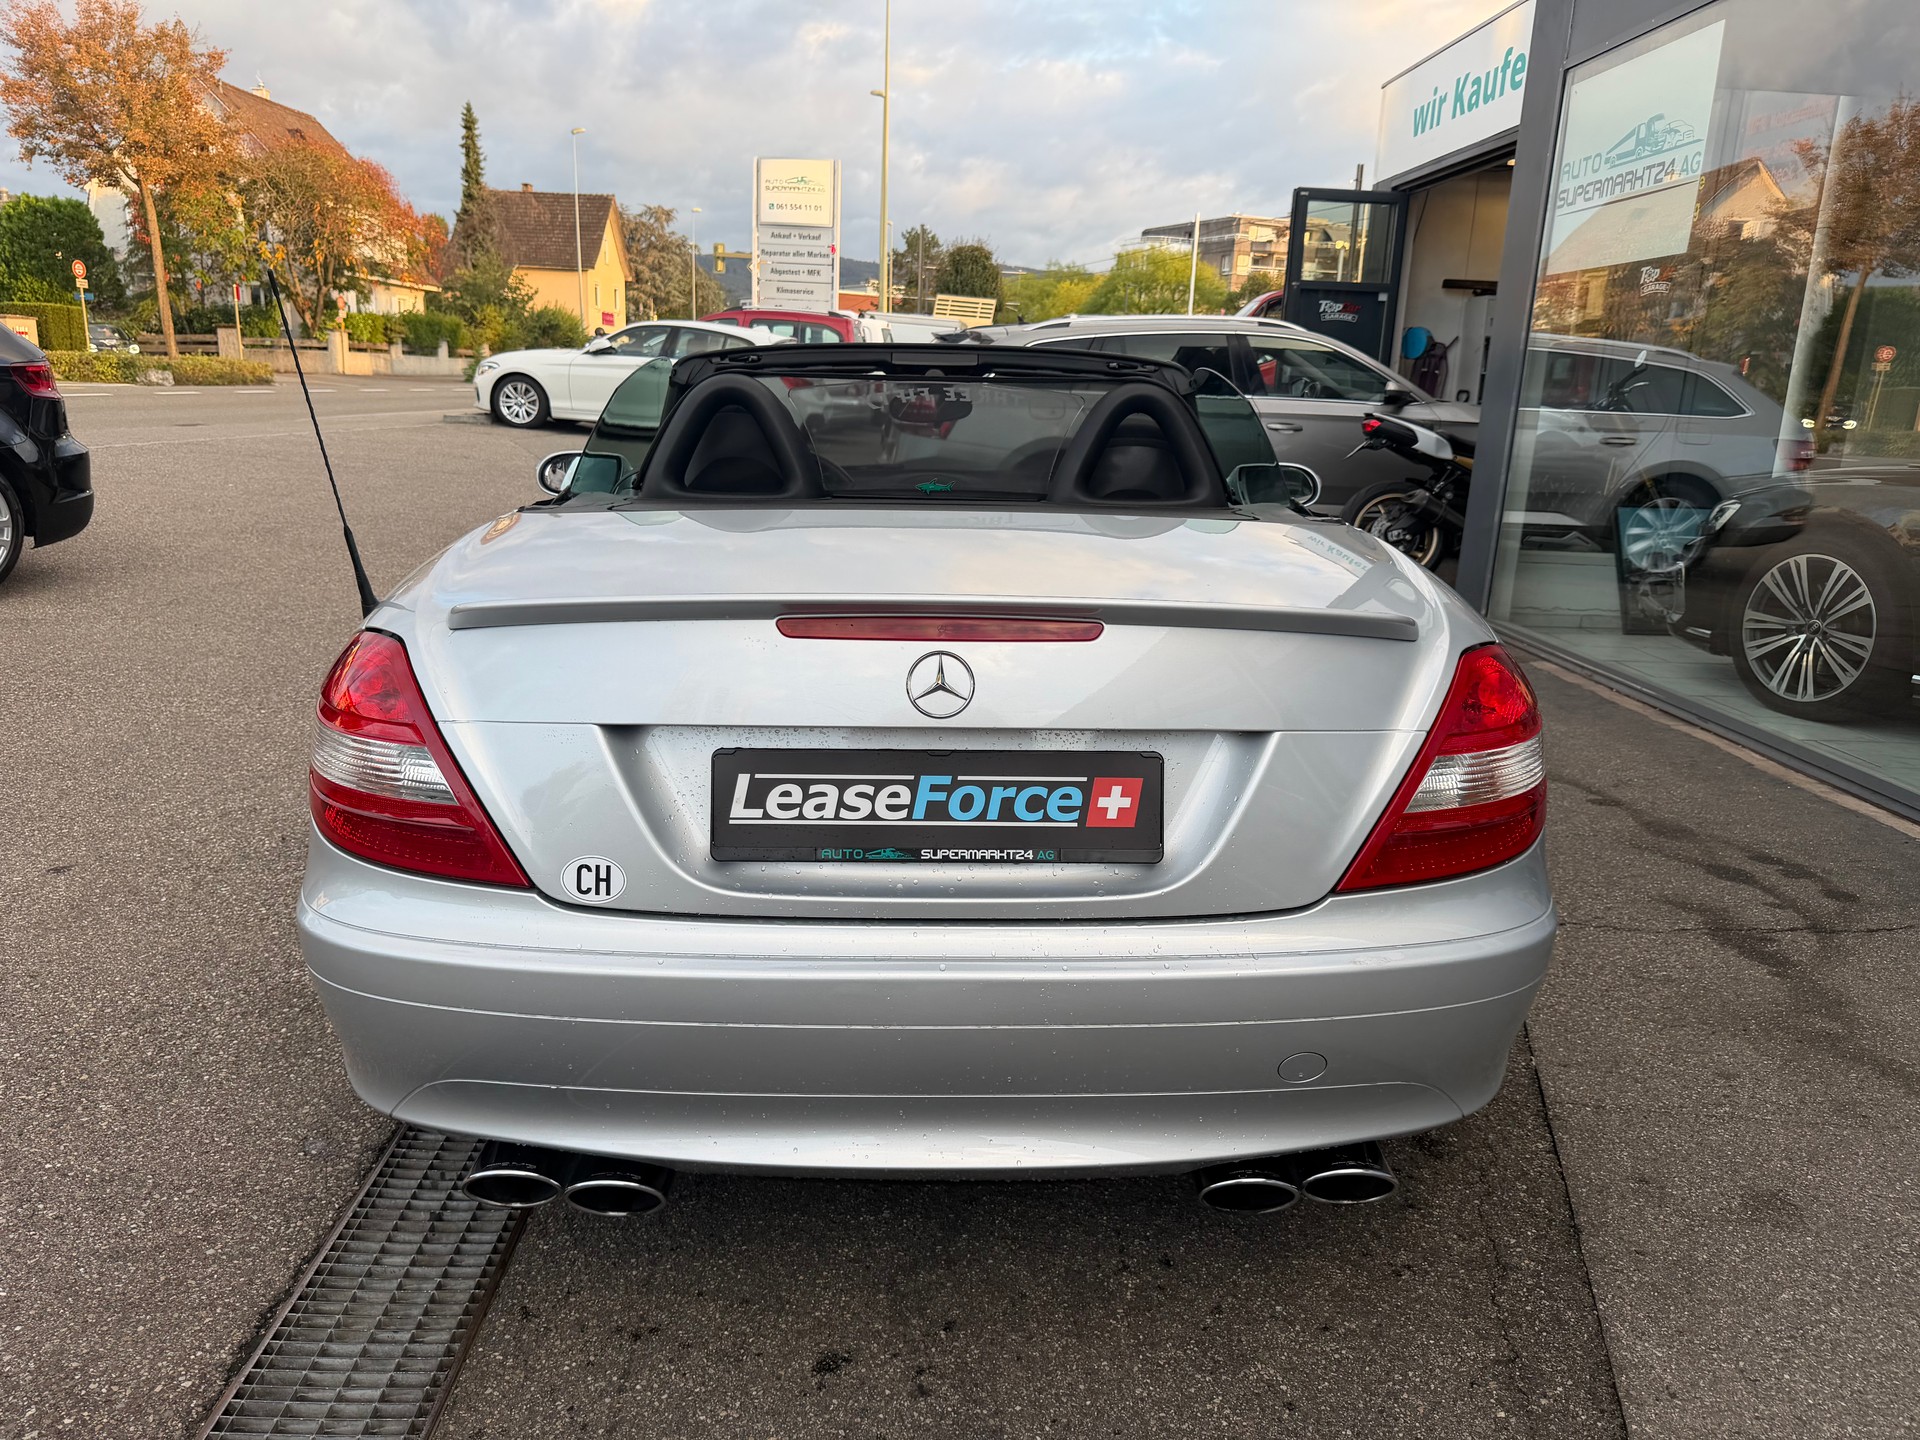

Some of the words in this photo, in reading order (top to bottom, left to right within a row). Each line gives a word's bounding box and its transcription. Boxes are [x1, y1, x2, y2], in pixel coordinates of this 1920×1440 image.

[1413, 86, 1448, 137] wir
[1451, 46, 1526, 120] Kaufe
[1561, 153, 1602, 183] AUTO
[1556, 158, 1676, 209] SUPERMARKT24
[1680, 151, 1702, 175] AG
[790, 203, 802, 211] 554
[770, 231, 792, 239] Ankauf
[798, 232, 822, 241] Verkauf
[761, 248, 791, 257] Reparatur
[807, 250, 830, 259] Marken
[807, 269, 821, 277] MFK
[776, 286, 814, 296] Klimaservice
[729, 773, 1082, 822] LeaseForce
[821, 849, 864, 860] AUTO
[920, 849, 1033, 860] SUPERMARKT24
[1037, 850, 1055, 860] AG
[576, 864, 611, 896] CH
